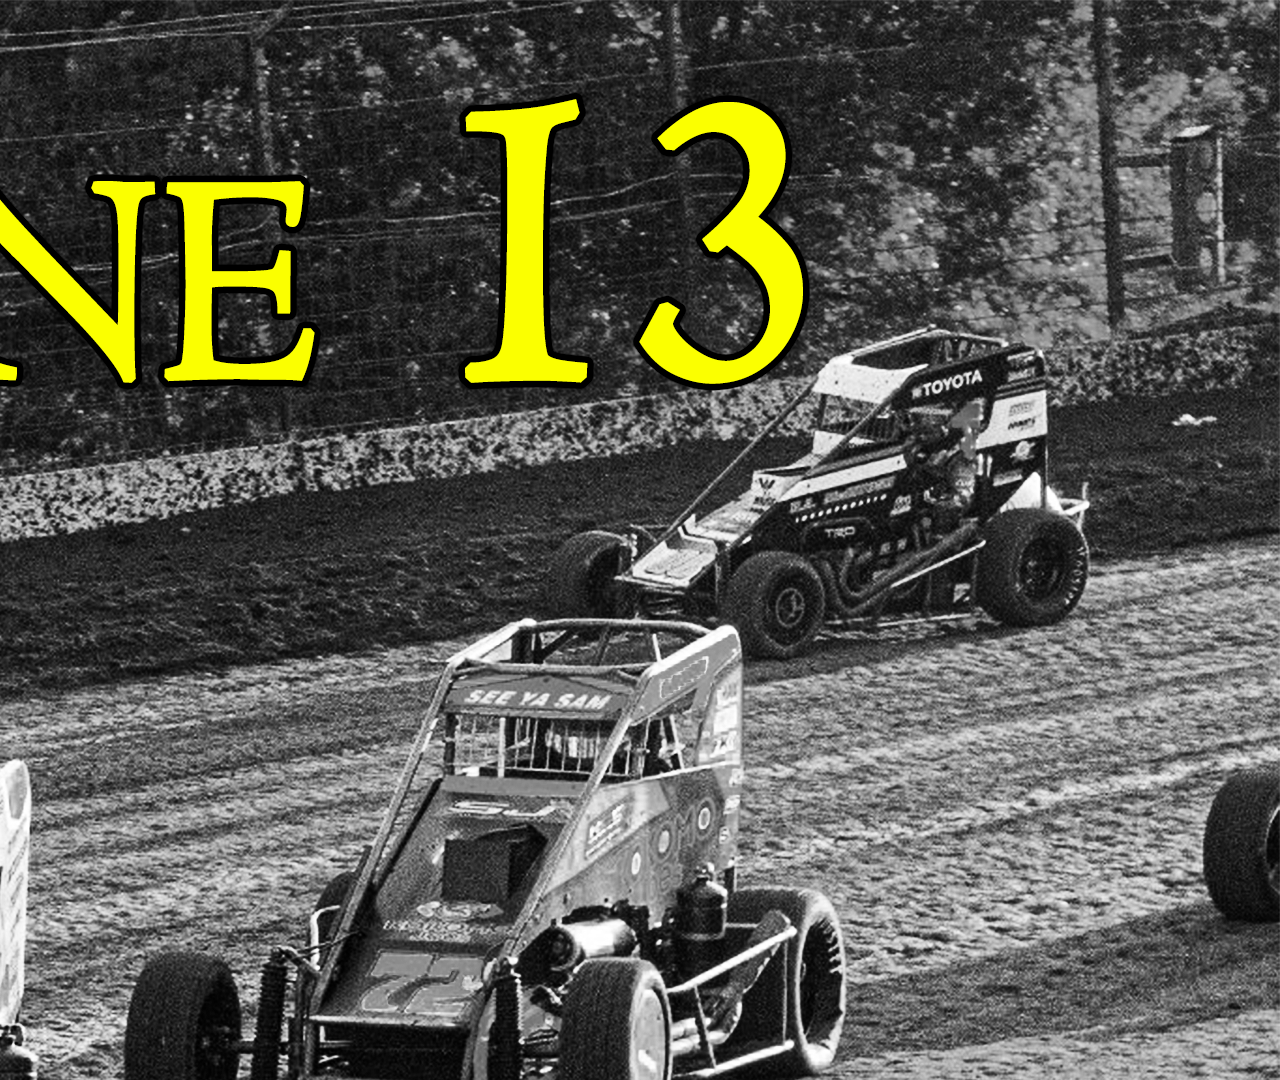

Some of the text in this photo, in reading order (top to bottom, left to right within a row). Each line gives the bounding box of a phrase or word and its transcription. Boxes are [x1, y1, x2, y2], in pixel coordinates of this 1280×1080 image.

[922, 368, 983, 397] TOYOTA
[464, 690, 612, 710] SEE YA SAM
